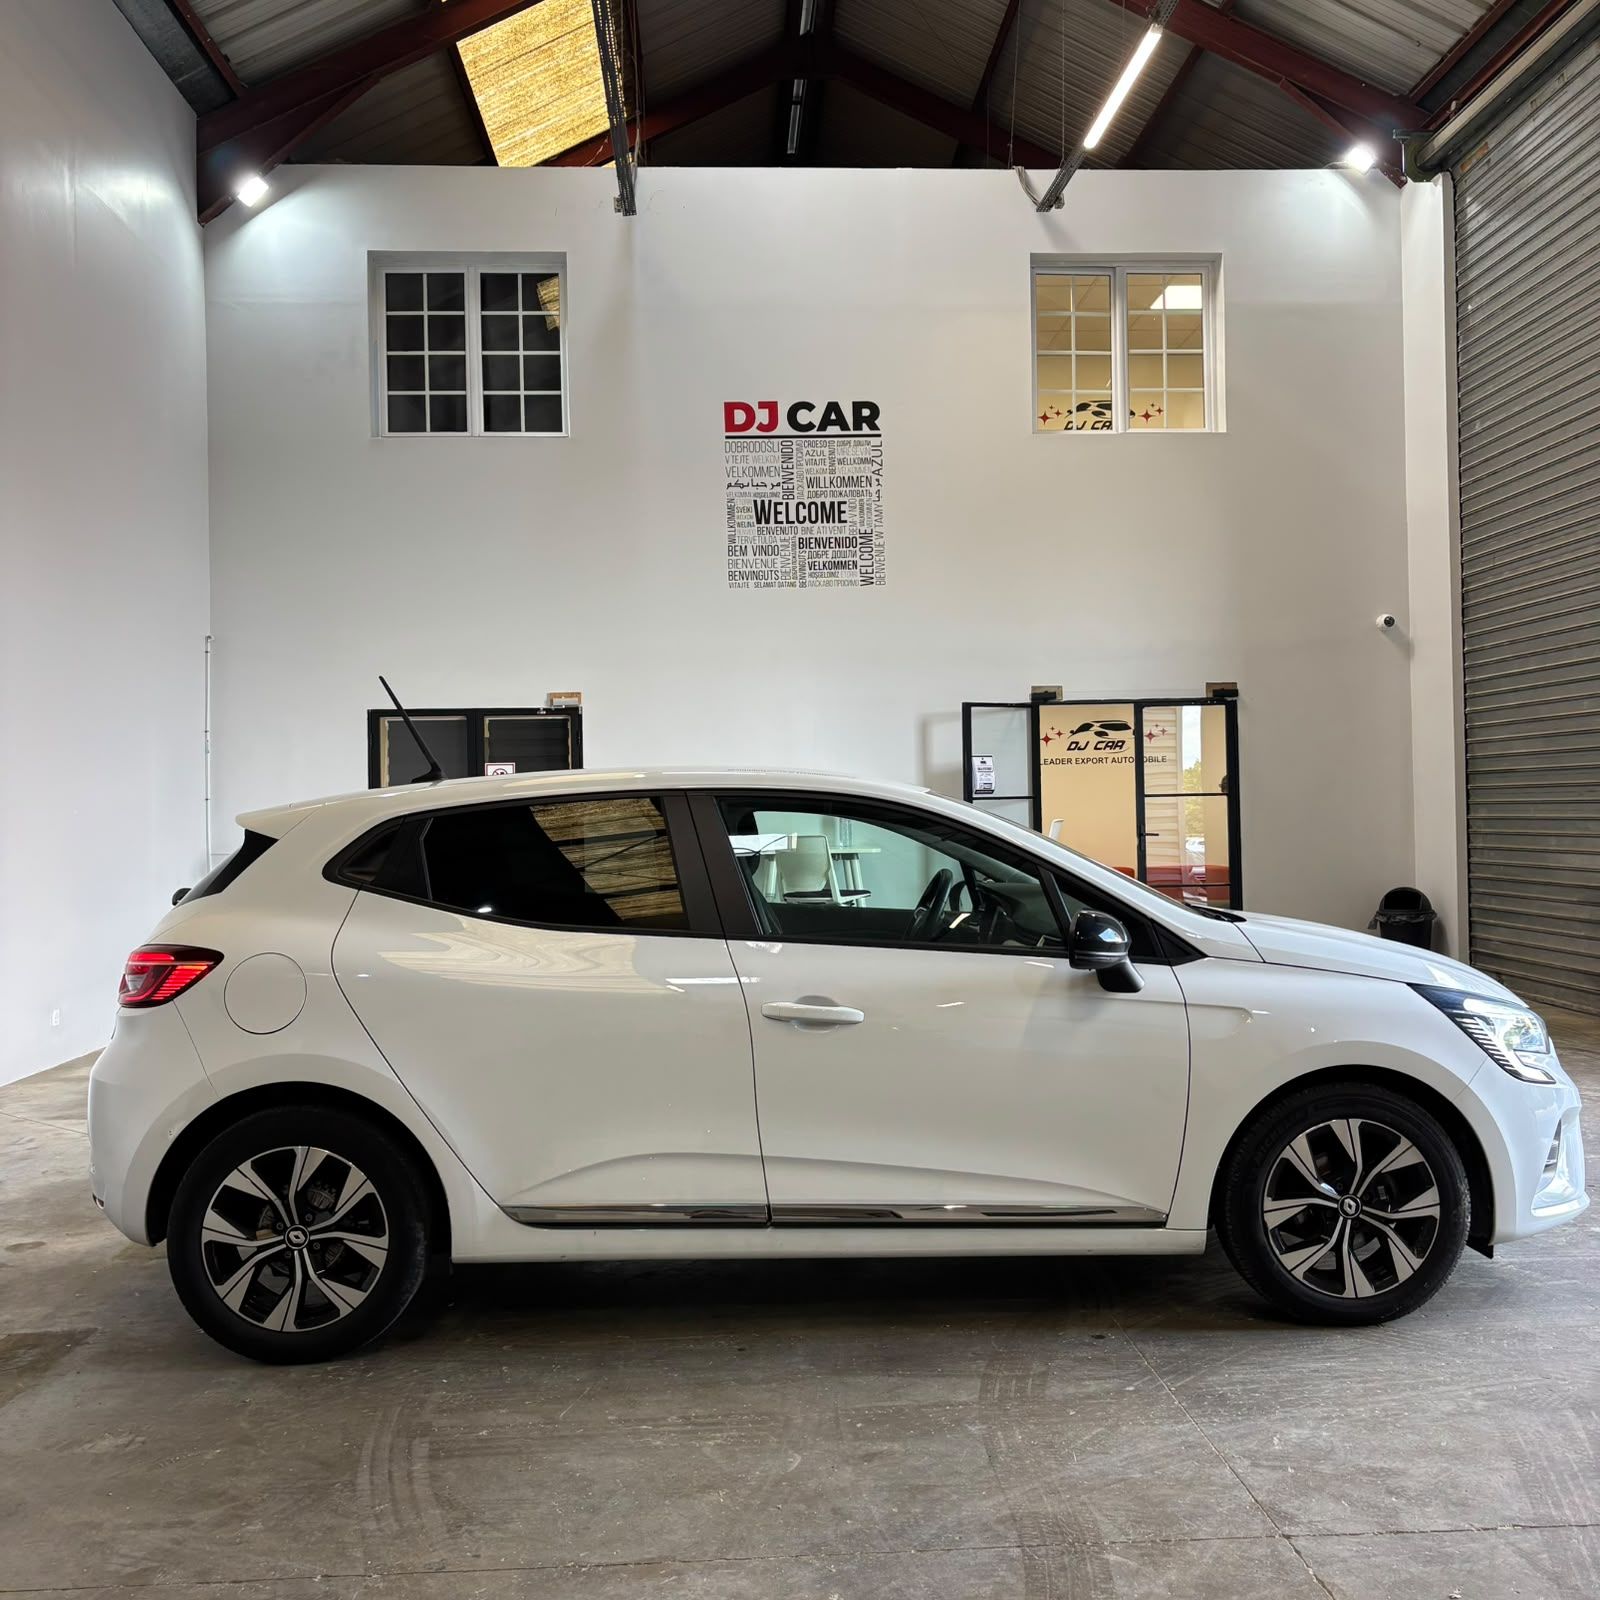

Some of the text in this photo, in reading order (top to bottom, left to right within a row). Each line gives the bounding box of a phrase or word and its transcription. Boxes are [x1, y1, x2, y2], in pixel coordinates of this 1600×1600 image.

[724, 401, 880, 432] DJ CAR
[1091, 421, 1112, 430] CA
[804, 440, 827, 448] CROESO
[872, 440, 883, 476] AZUL
[725, 466, 780, 478] VELKOMMEN
[781, 440, 794, 500] BIENVENIDO
[806, 476, 872, 488] WILLKOMMEN
[807, 490, 872, 499] ДОБРО ПОЖАЛОВАТЬ
[753, 500, 848, 524] WELCOME
[727, 498, 736, 544] WILLKOMMEN
[757, 526, 798, 535] BENVENUTO
[798, 536, 857, 549] BIENVENIDO
[728, 545, 779, 557] BEM VINDO
[808, 550, 857, 559] ДОБРЕ ДОШЛИ
[859, 528, 874, 586] WELCOME
[728, 558, 778, 569] BIENVENUE
[808, 560, 857, 570] VELKOMMEN
[875, 541, 886, 586] BIENVENUE
[728, 570, 779, 581] BENVINGUTS
[1067, 740, 1126, 751] DJ CAR
[1111, 755, 1167, 764] AUTOOBILE
